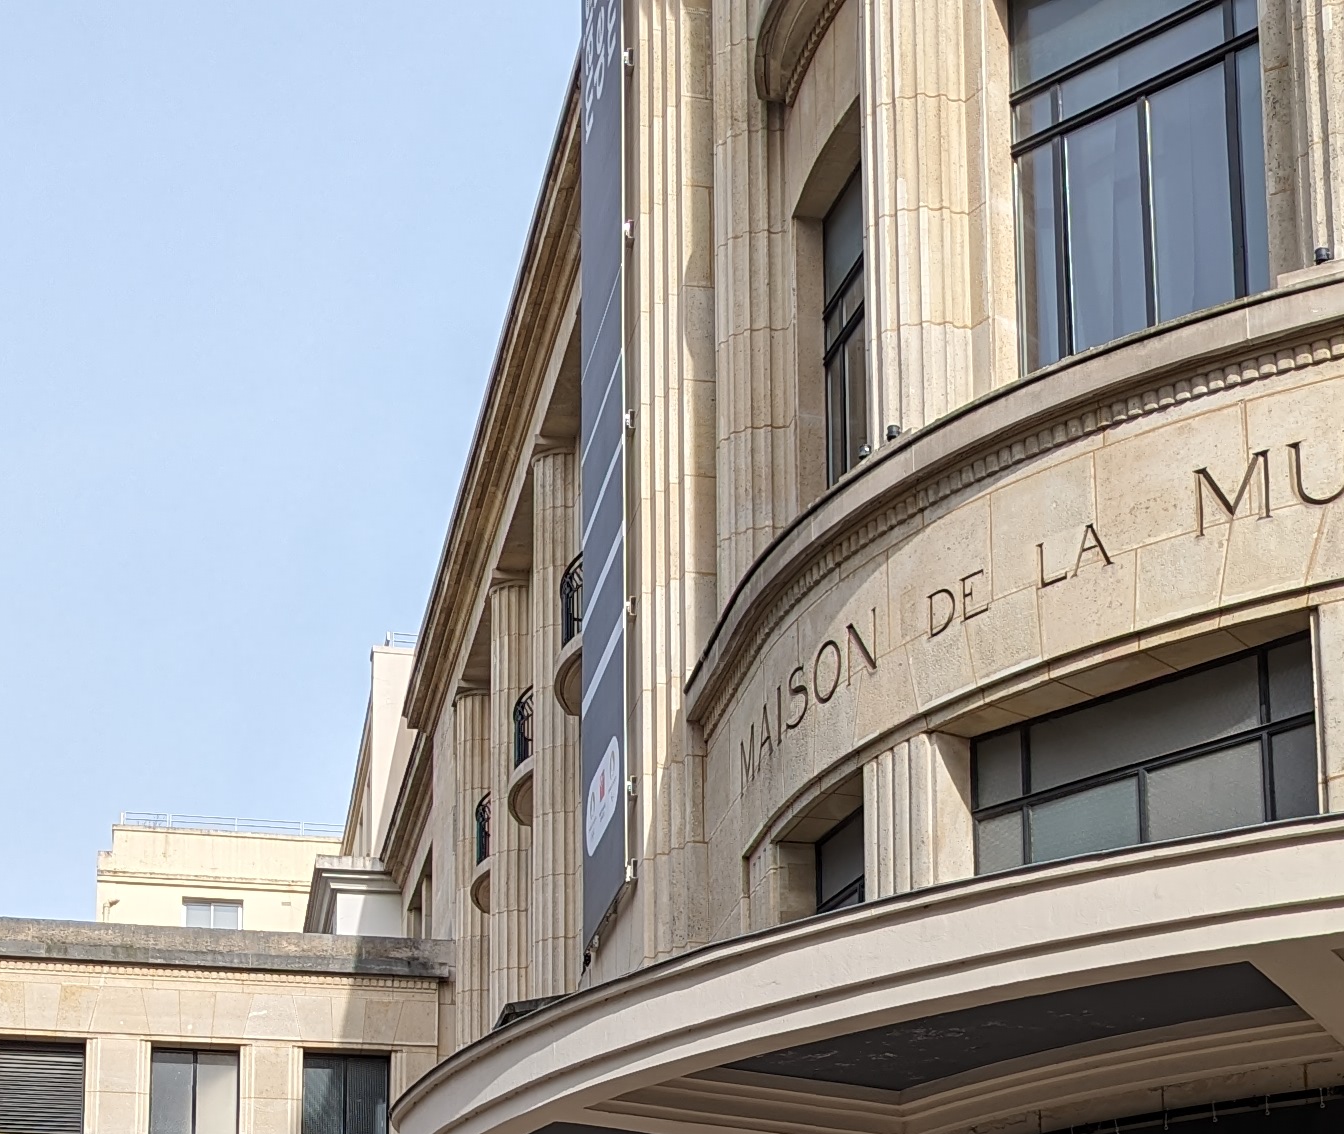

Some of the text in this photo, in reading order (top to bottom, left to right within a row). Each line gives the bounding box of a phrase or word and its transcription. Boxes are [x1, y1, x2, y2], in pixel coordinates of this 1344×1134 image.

[739, 607, 878, 783] MAISON
[926, 569, 989, 639] DE
[1037, 522, 1115, 589] LA
